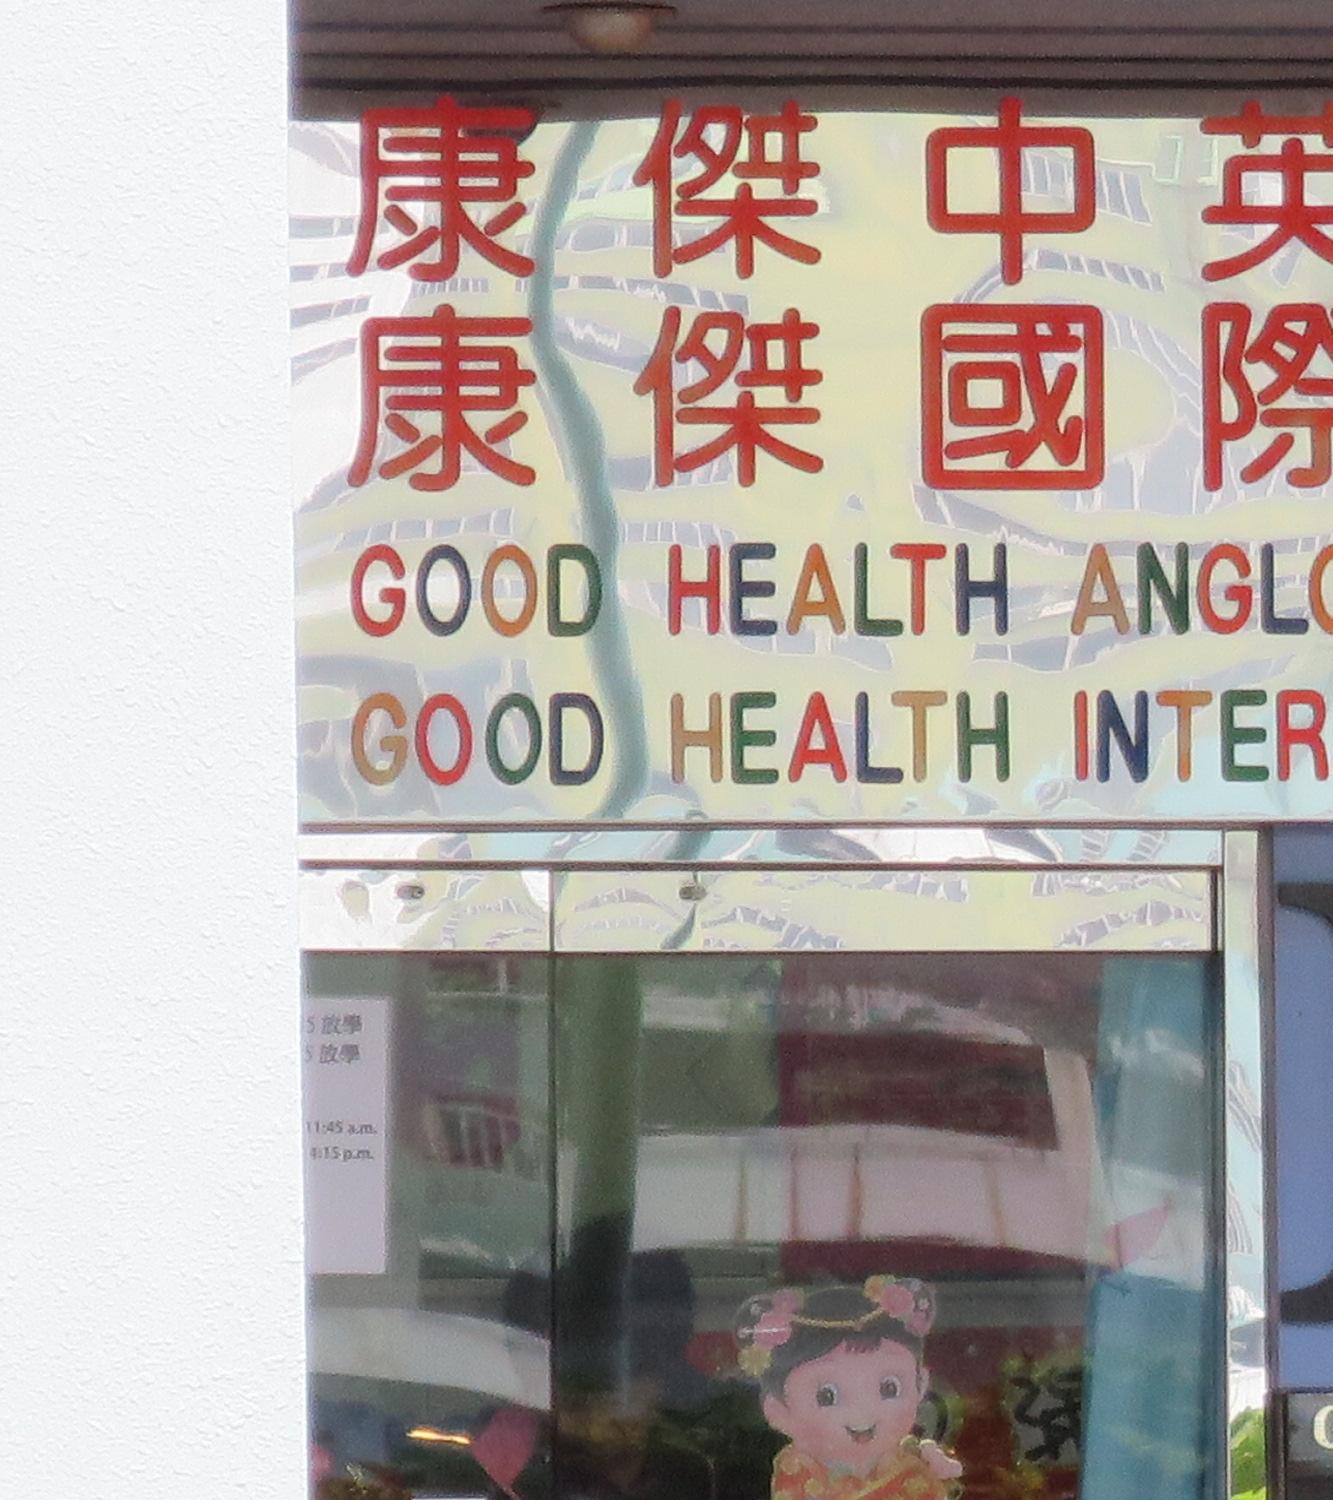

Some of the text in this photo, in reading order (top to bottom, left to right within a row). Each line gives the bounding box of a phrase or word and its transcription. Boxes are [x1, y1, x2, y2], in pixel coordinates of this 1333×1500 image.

[350, 543, 602, 637] GOOD
[668, 543, 1009, 637] HEALTH
[350, 692, 603, 786] GOOD
[671, 691, 1011, 785] HEALTH
